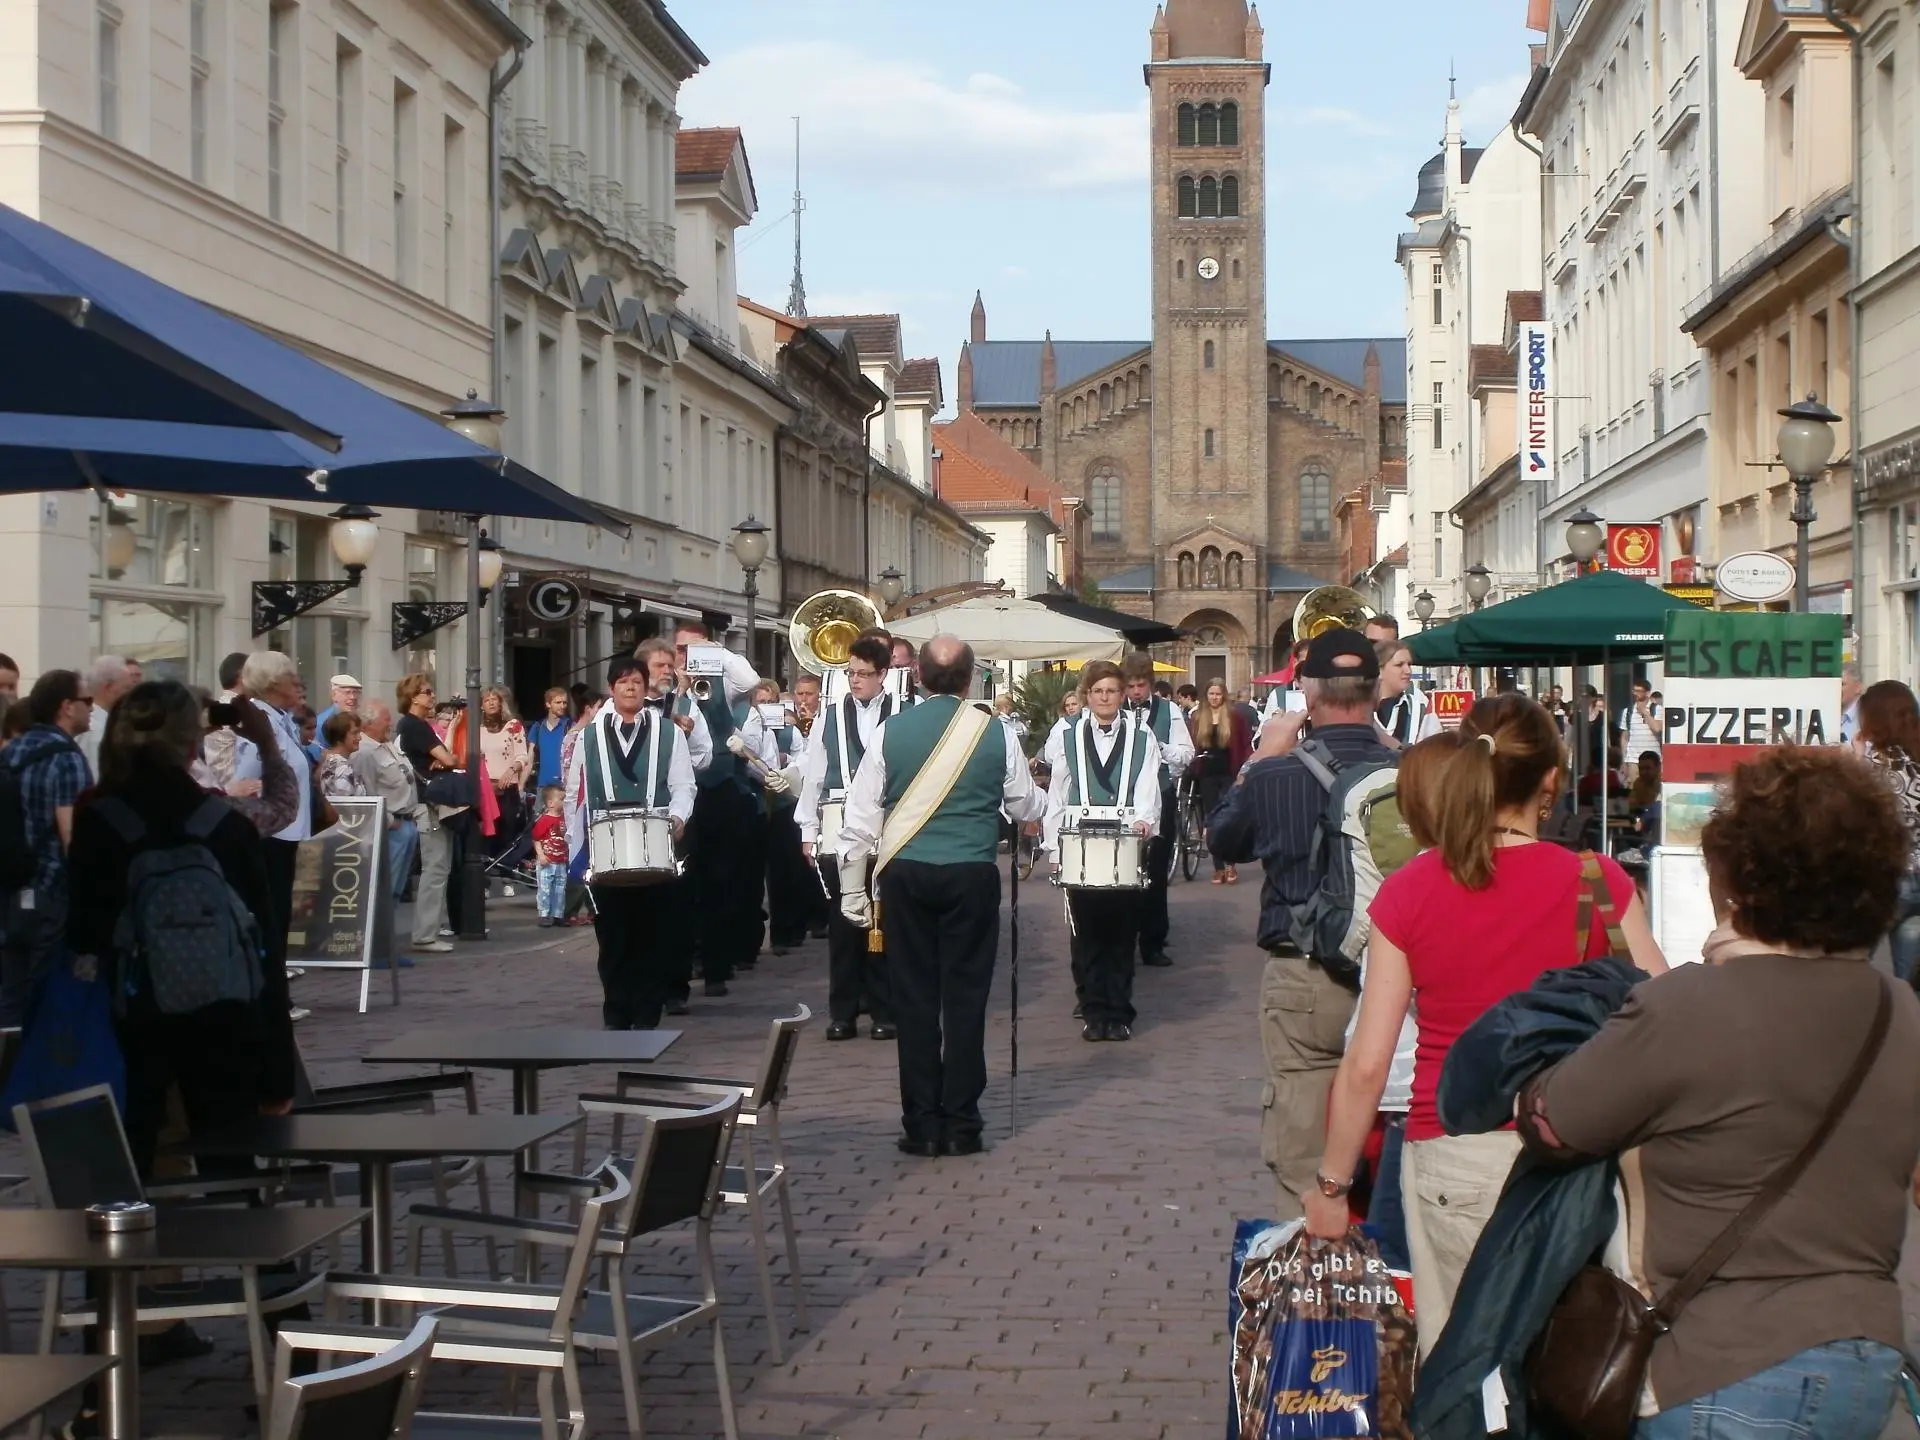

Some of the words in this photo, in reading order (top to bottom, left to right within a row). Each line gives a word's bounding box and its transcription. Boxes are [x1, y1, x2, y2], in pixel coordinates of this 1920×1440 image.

[1528, 330, 1546, 449] INTERSPORT
[535, 582, 572, 619] G
[1664, 640, 1721, 677] EIS
[1730, 640, 1833, 677] CAFE
[1664, 704, 1826, 745] PIZZERIA
[1312, 1253, 1353, 1281] gibt
[1333, 1284, 1403, 1306] Tchib
[1274, 1388, 1369, 1414] Tchibo
